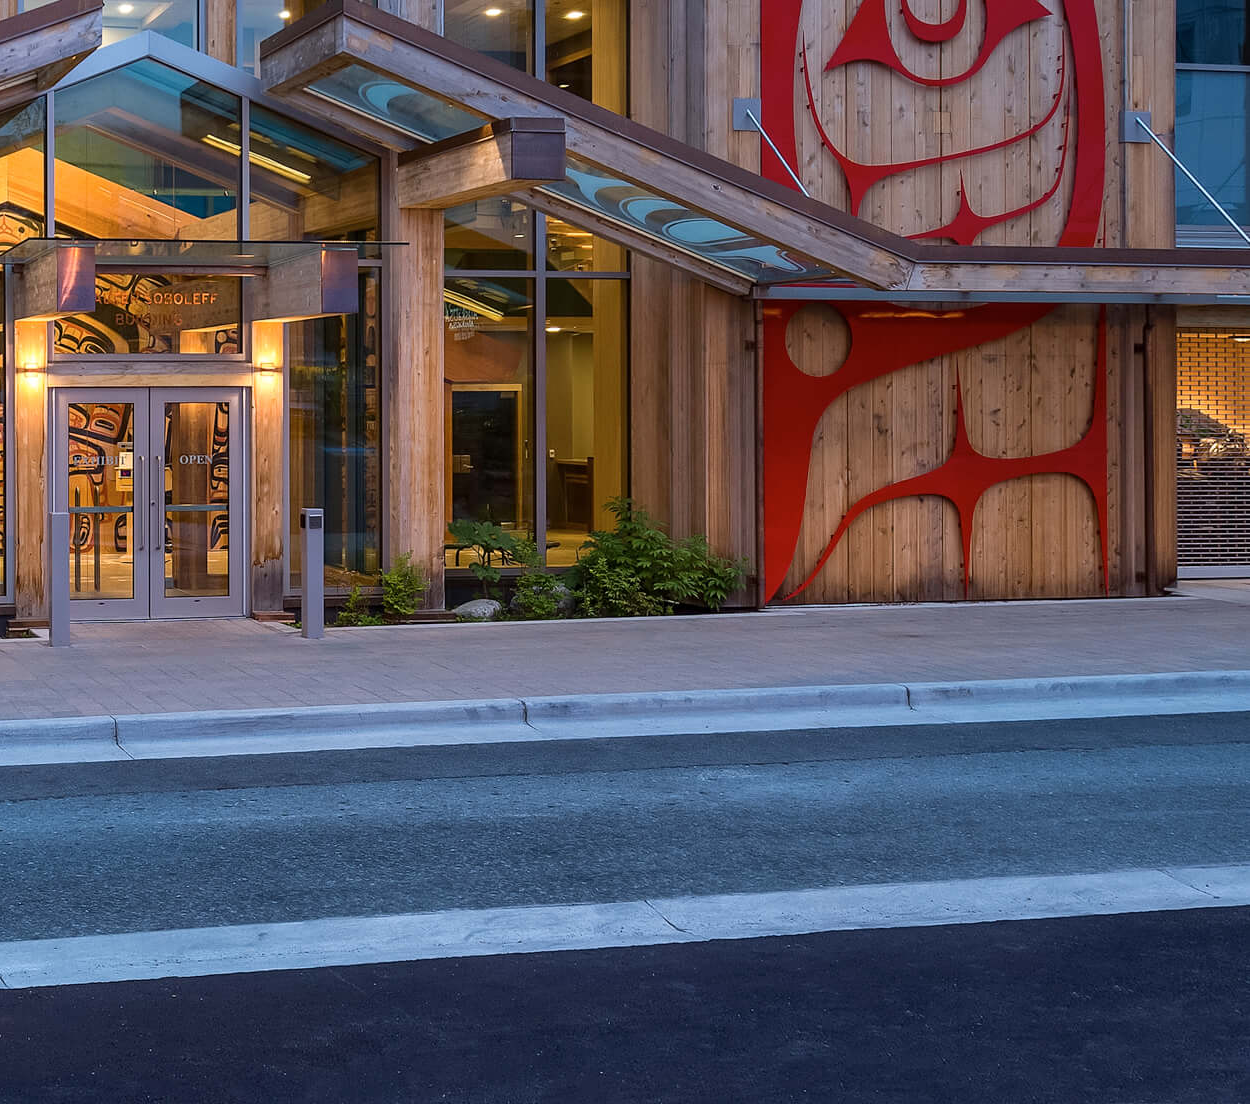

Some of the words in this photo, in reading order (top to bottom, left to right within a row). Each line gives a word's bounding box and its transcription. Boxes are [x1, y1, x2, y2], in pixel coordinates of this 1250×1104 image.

[115, 313, 183, 326] BUDING
[73, 455, 127, 465] EXHIBIT
[179, 454, 214, 465] OPEN
